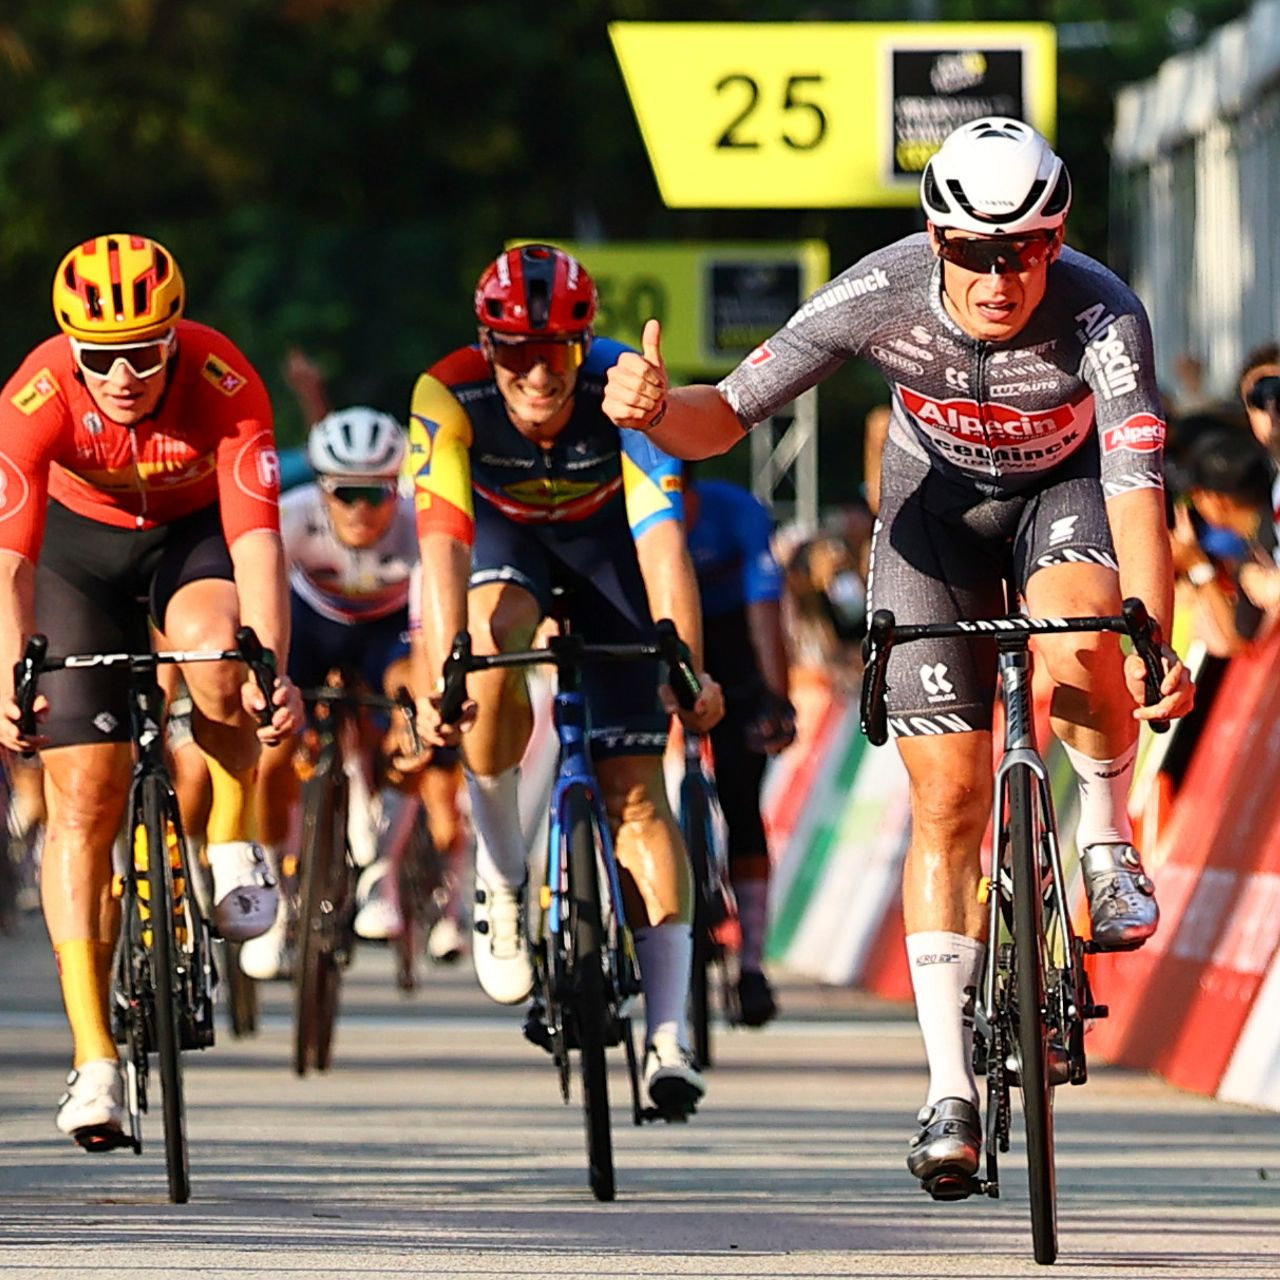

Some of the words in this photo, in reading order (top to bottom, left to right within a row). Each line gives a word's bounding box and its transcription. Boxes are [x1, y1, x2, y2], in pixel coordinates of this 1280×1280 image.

[712, 73, 829, 151] 25
[917, 401, 1059, 436] Alpecin
[932, 430, 1080, 462] ceuninck
[956, 617, 1069, 632] CANYON
